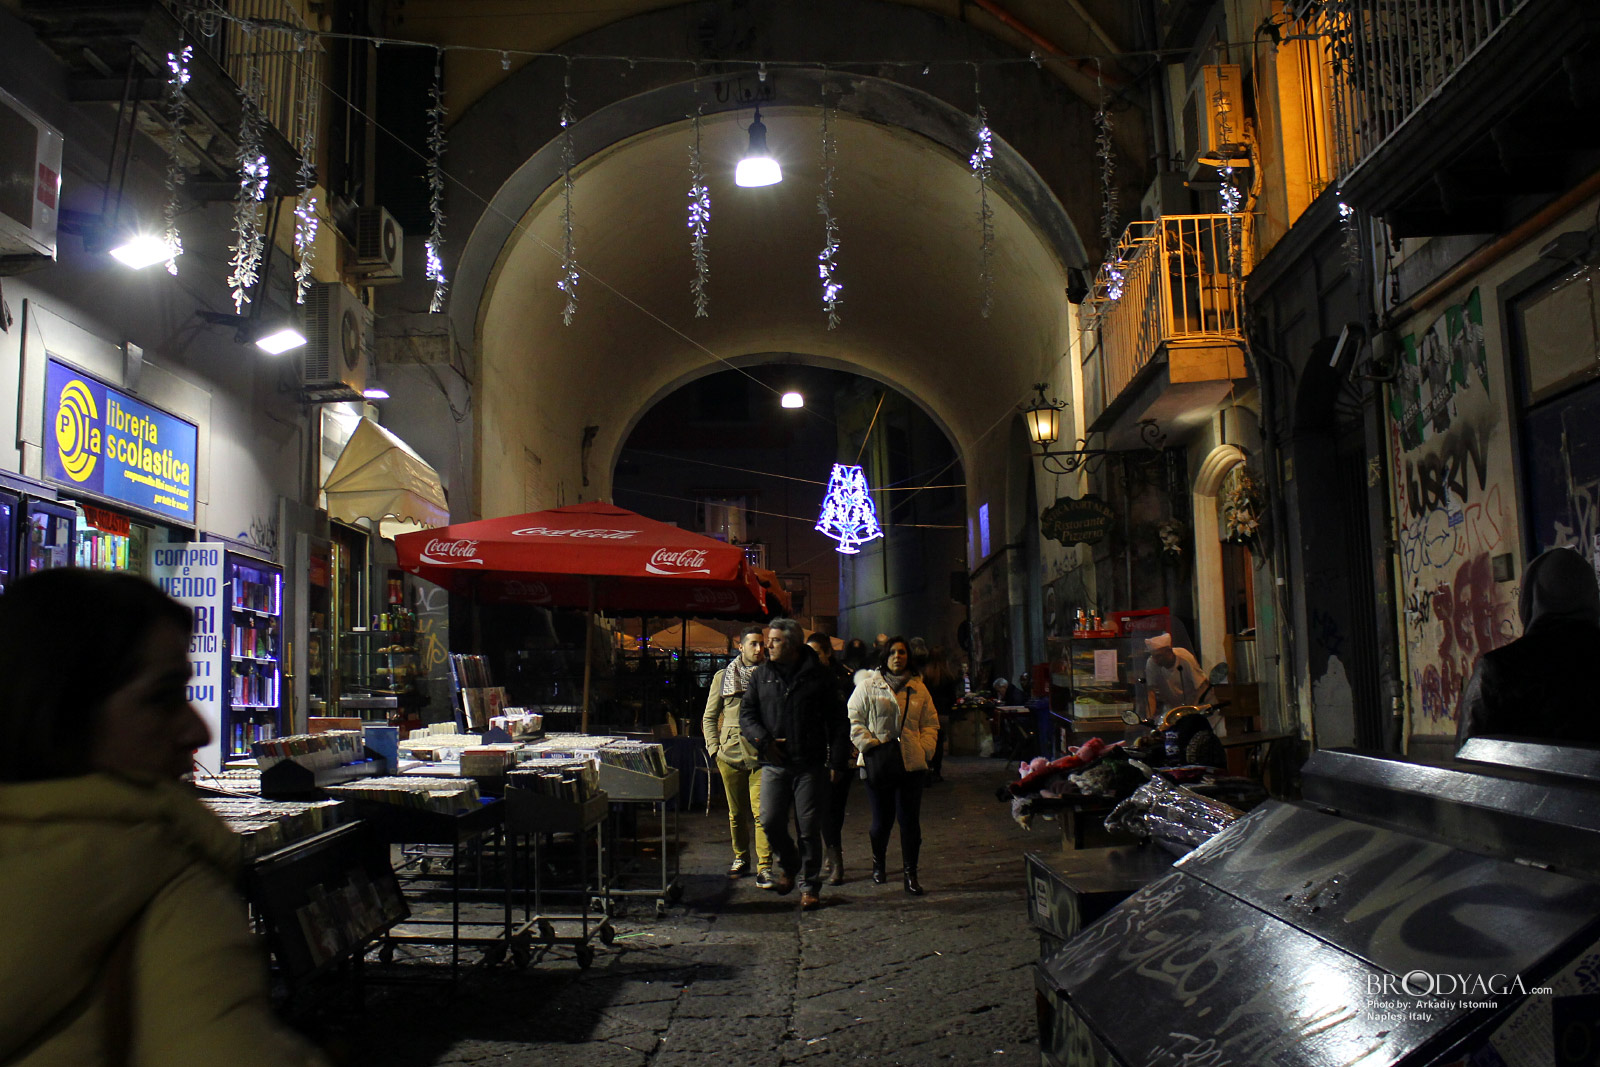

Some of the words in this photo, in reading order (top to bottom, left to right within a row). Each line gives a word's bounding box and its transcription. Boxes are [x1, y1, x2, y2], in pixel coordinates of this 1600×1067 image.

[106, 398, 158, 445] libreria
[84, 416, 101, 454] la
[106, 434, 189, 486] scolastica
[511, 527, 643, 539] Coca-Cola
[1054, 516, 1105, 531] Ristorante
[154, 549, 218, 567] COMPRO
[424, 538, 480, 558] Coca-Cola
[650, 547, 710, 569] Coca-Cola
[183, 566, 190, 576] e
[159, 577, 216, 598] VENDO
